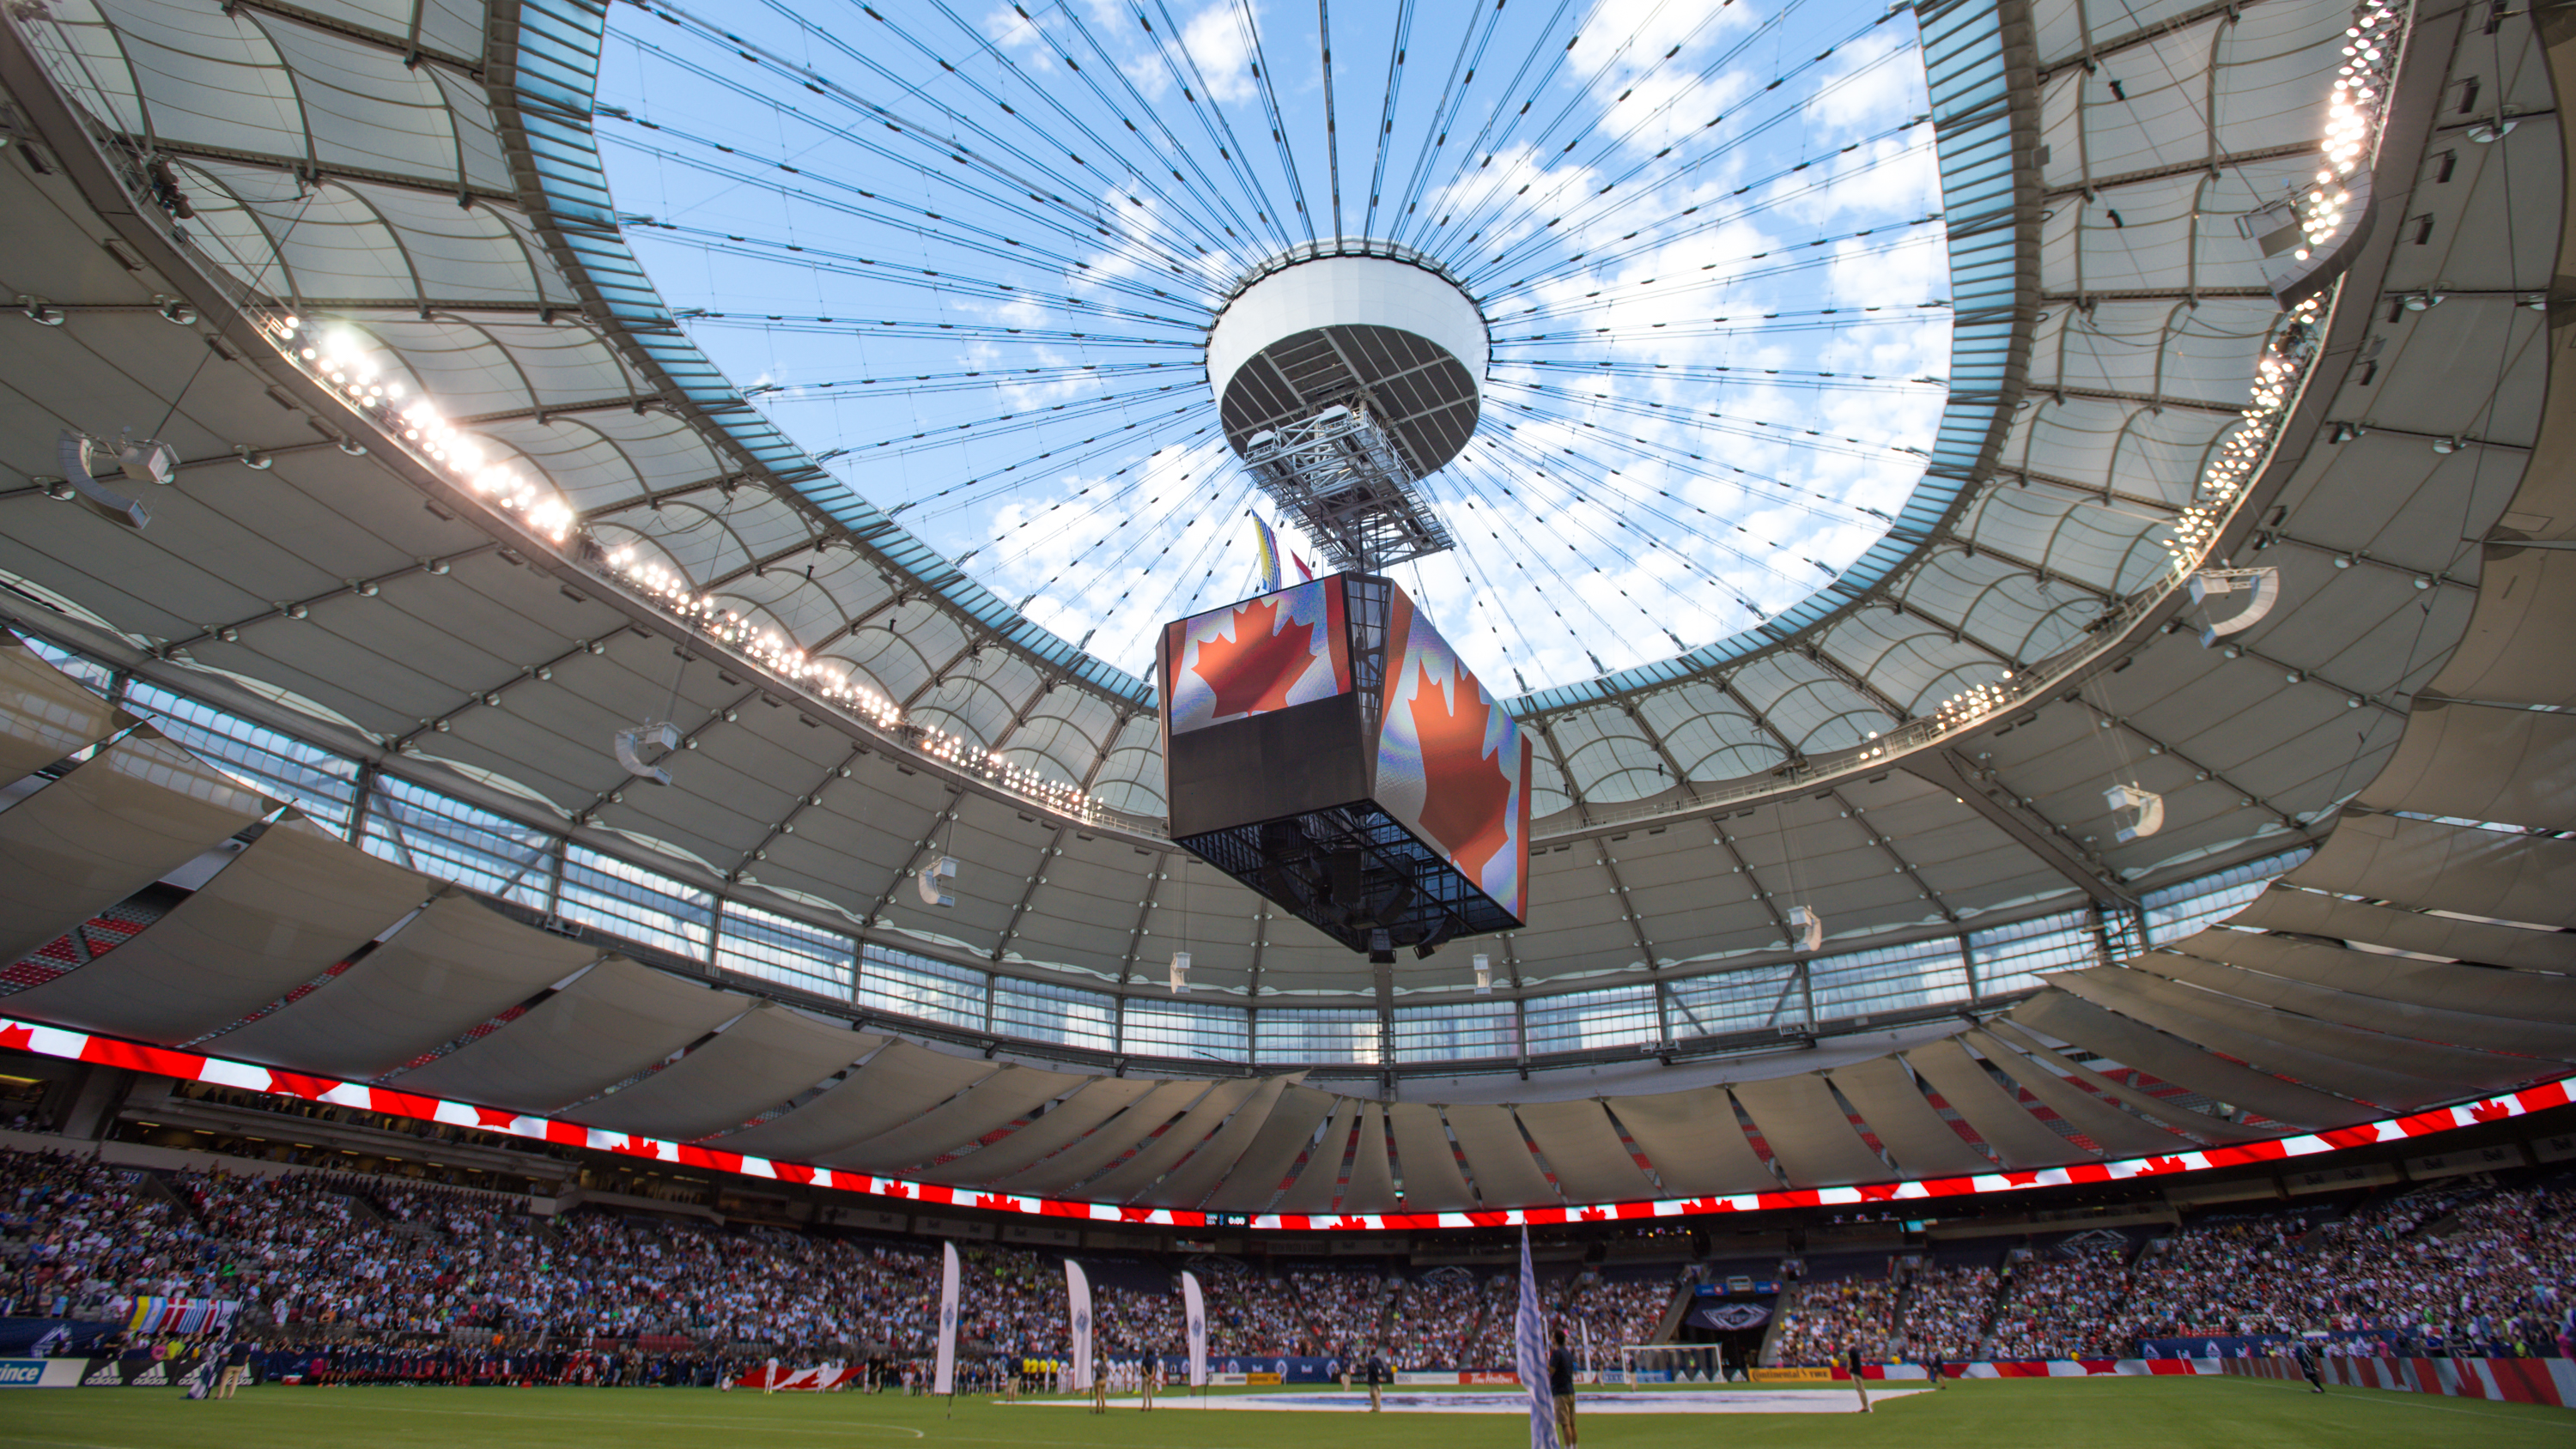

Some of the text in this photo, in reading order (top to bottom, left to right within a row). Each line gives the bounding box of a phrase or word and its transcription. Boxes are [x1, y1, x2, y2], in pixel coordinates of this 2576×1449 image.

[1228, 1216, 1245, 1225] 0:00
[0, 1363, 39, 1381] ince
[1752, 1370, 1800, 1381] Continental
[84, 1376, 123, 1385] adidas
[131, 1376, 169, 1385] adidas
[1471, 1372, 1485, 1384] Tim
